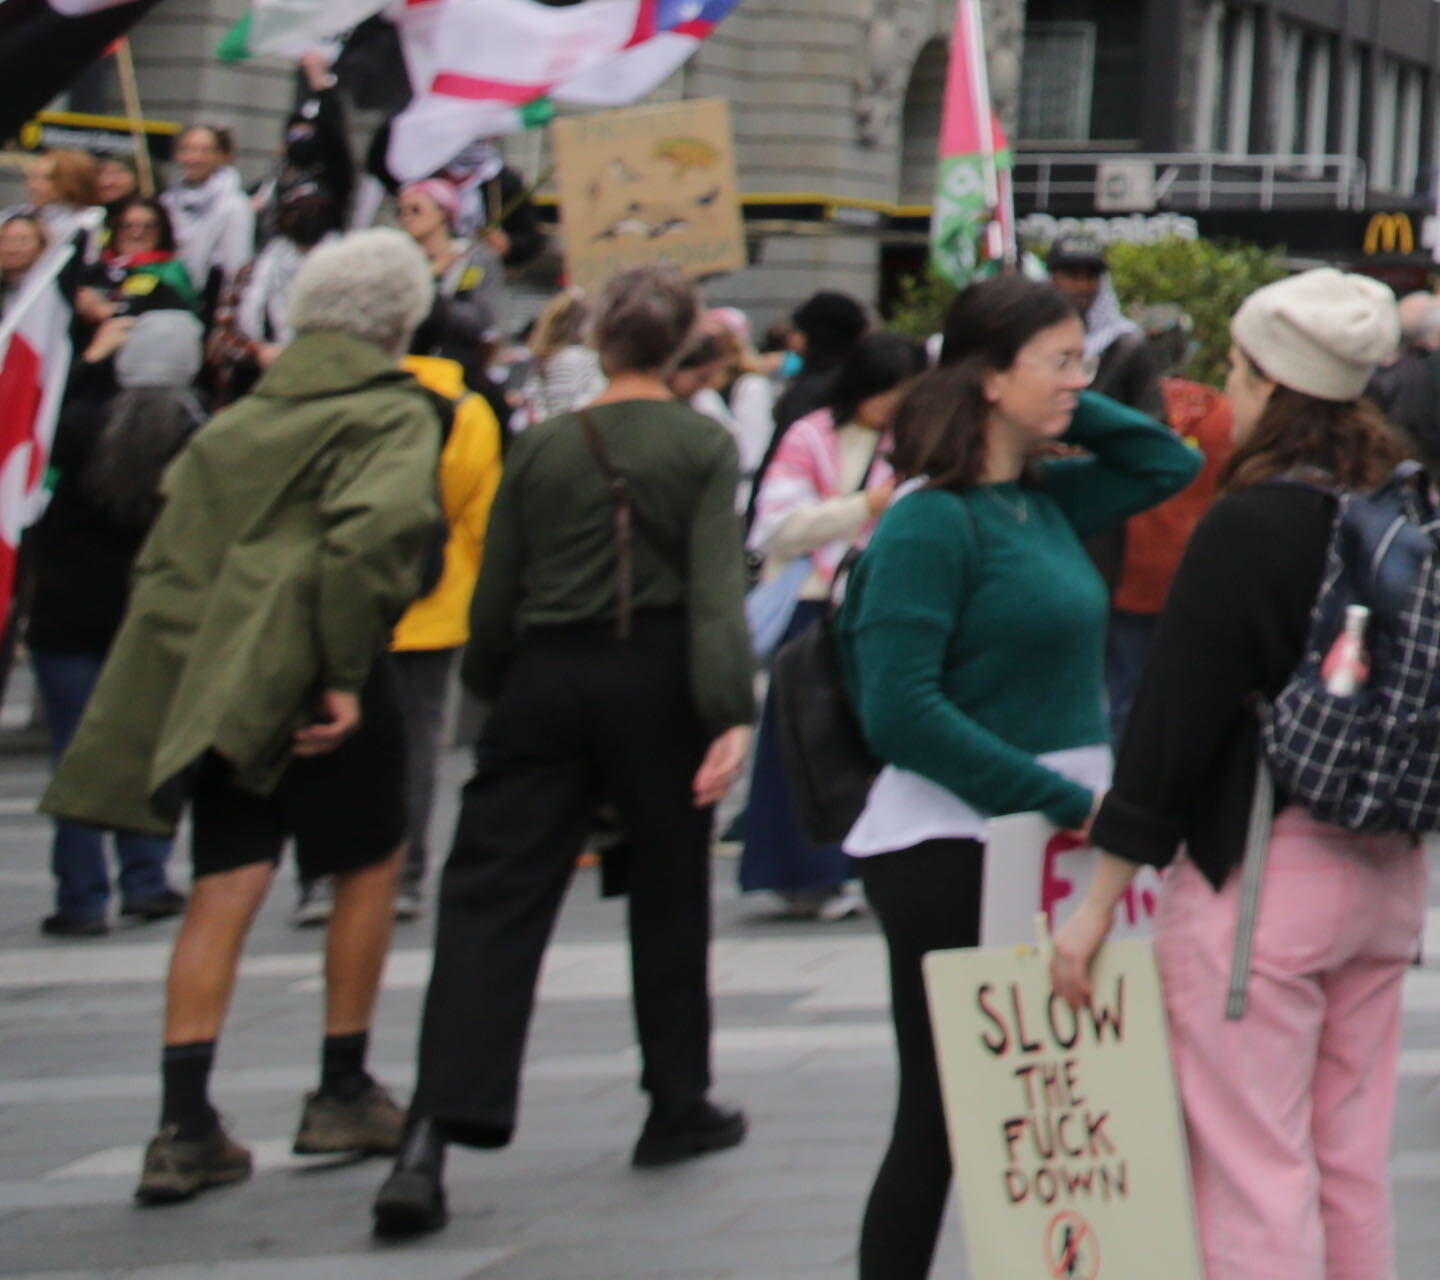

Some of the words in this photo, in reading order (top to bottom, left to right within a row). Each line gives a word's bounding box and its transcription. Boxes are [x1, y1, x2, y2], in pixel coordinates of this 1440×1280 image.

[976, 972, 1126, 1057] SLOW
[1014, 1058, 1085, 1110] THE
[1002, 1111, 1117, 1166] FUCK
[1004, 1158, 1129, 1206] DOWN
